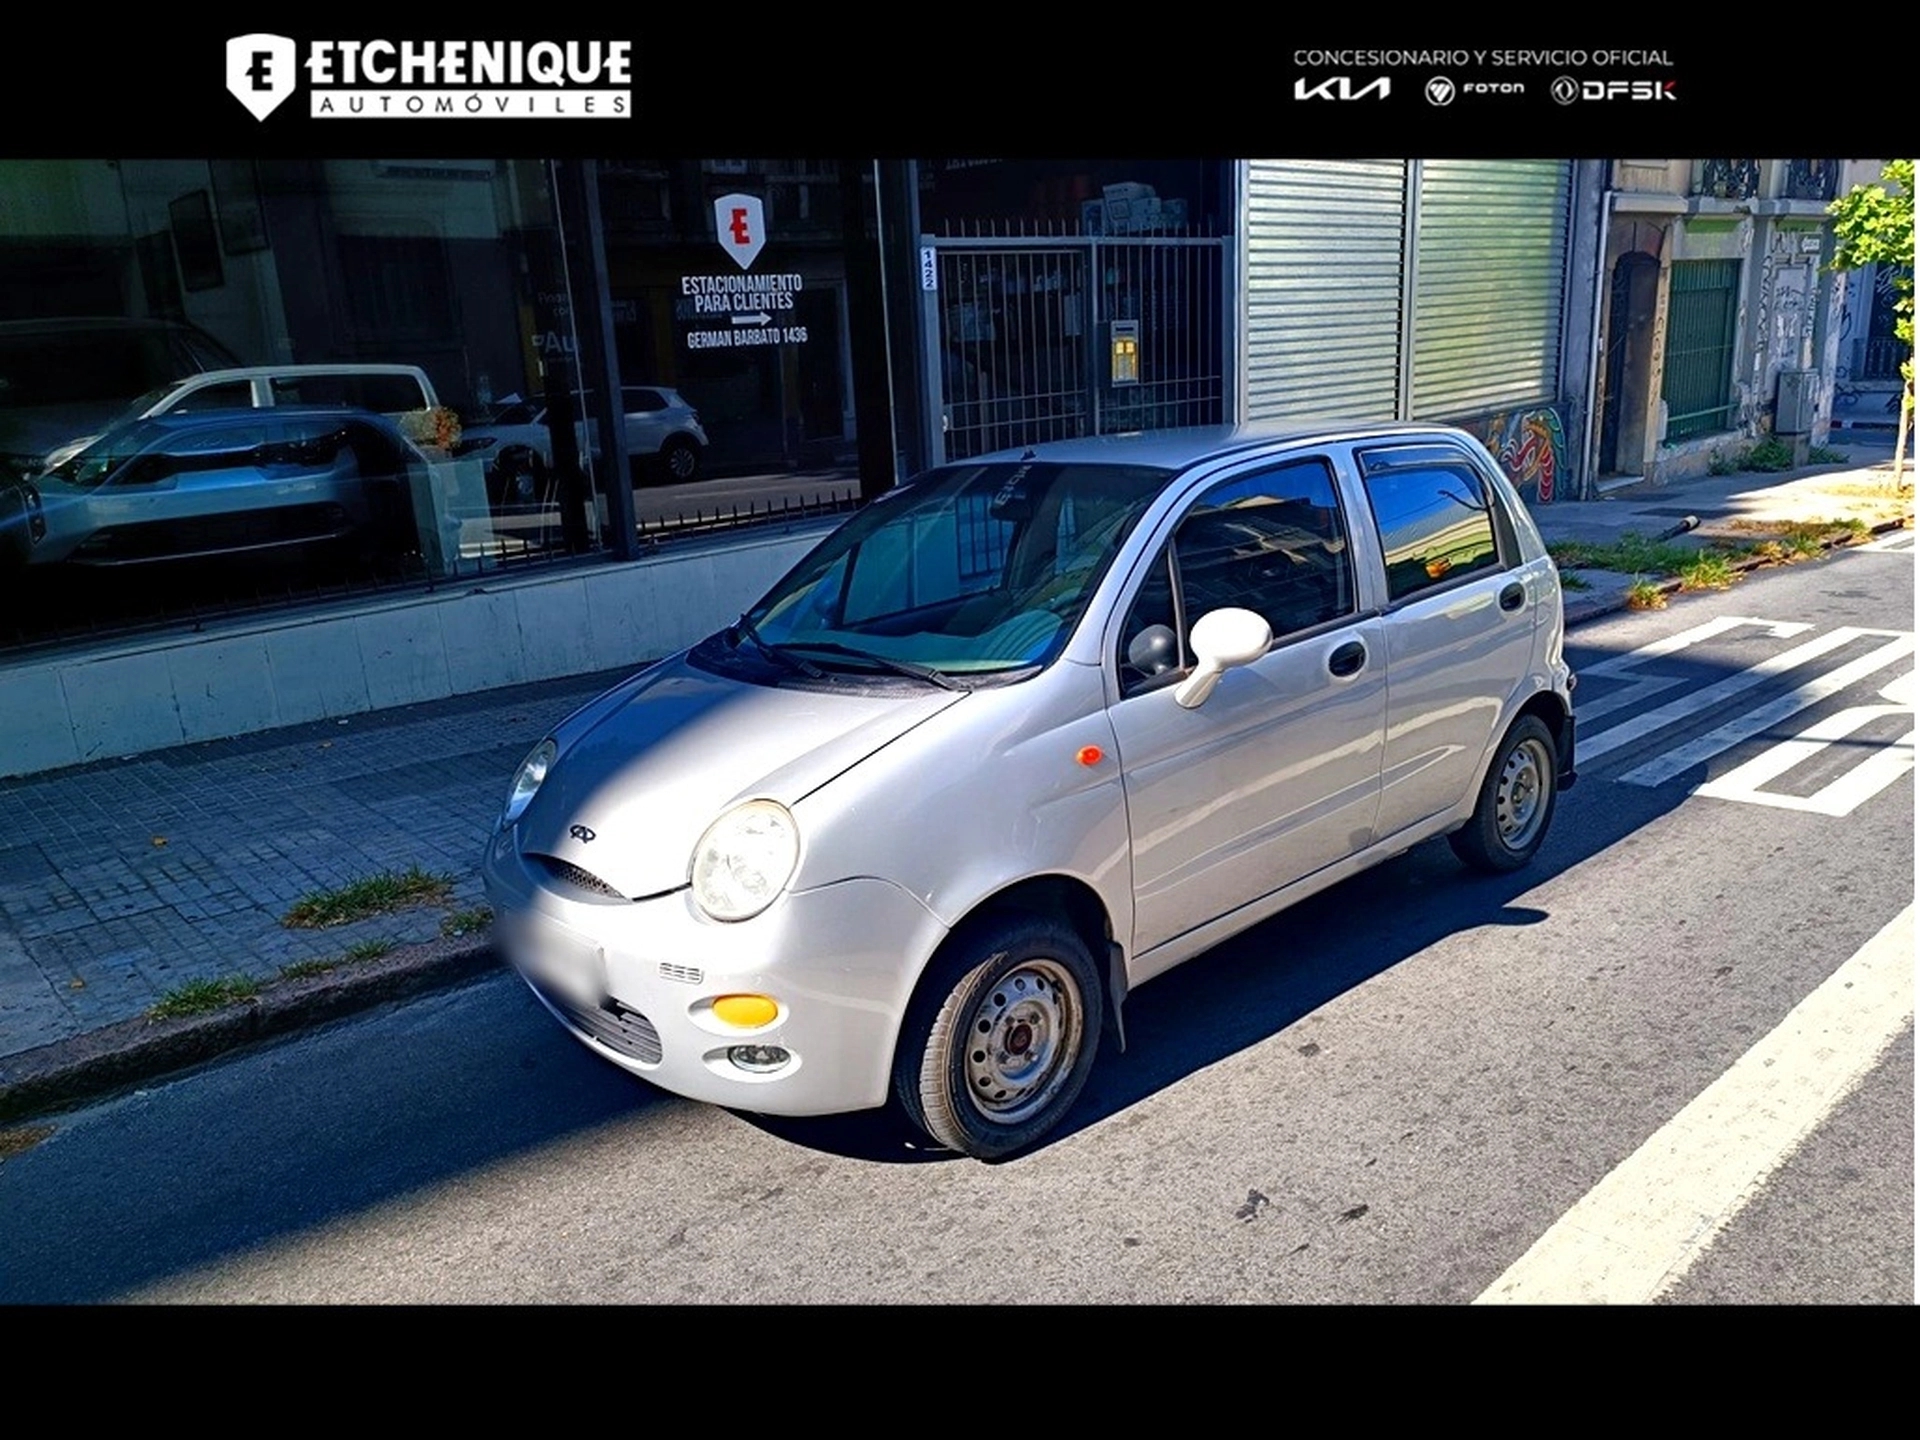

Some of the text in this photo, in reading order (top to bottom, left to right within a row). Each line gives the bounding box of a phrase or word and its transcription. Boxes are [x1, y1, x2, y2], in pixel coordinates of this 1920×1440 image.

[923, 250, 933, 288] 1422
[682, 274, 801, 295] ESTACIONAMIENTO
[694, 287, 794, 313] PARA CLIENTES
[687, 326, 808, 349] GERMAN BARBATO 1436
